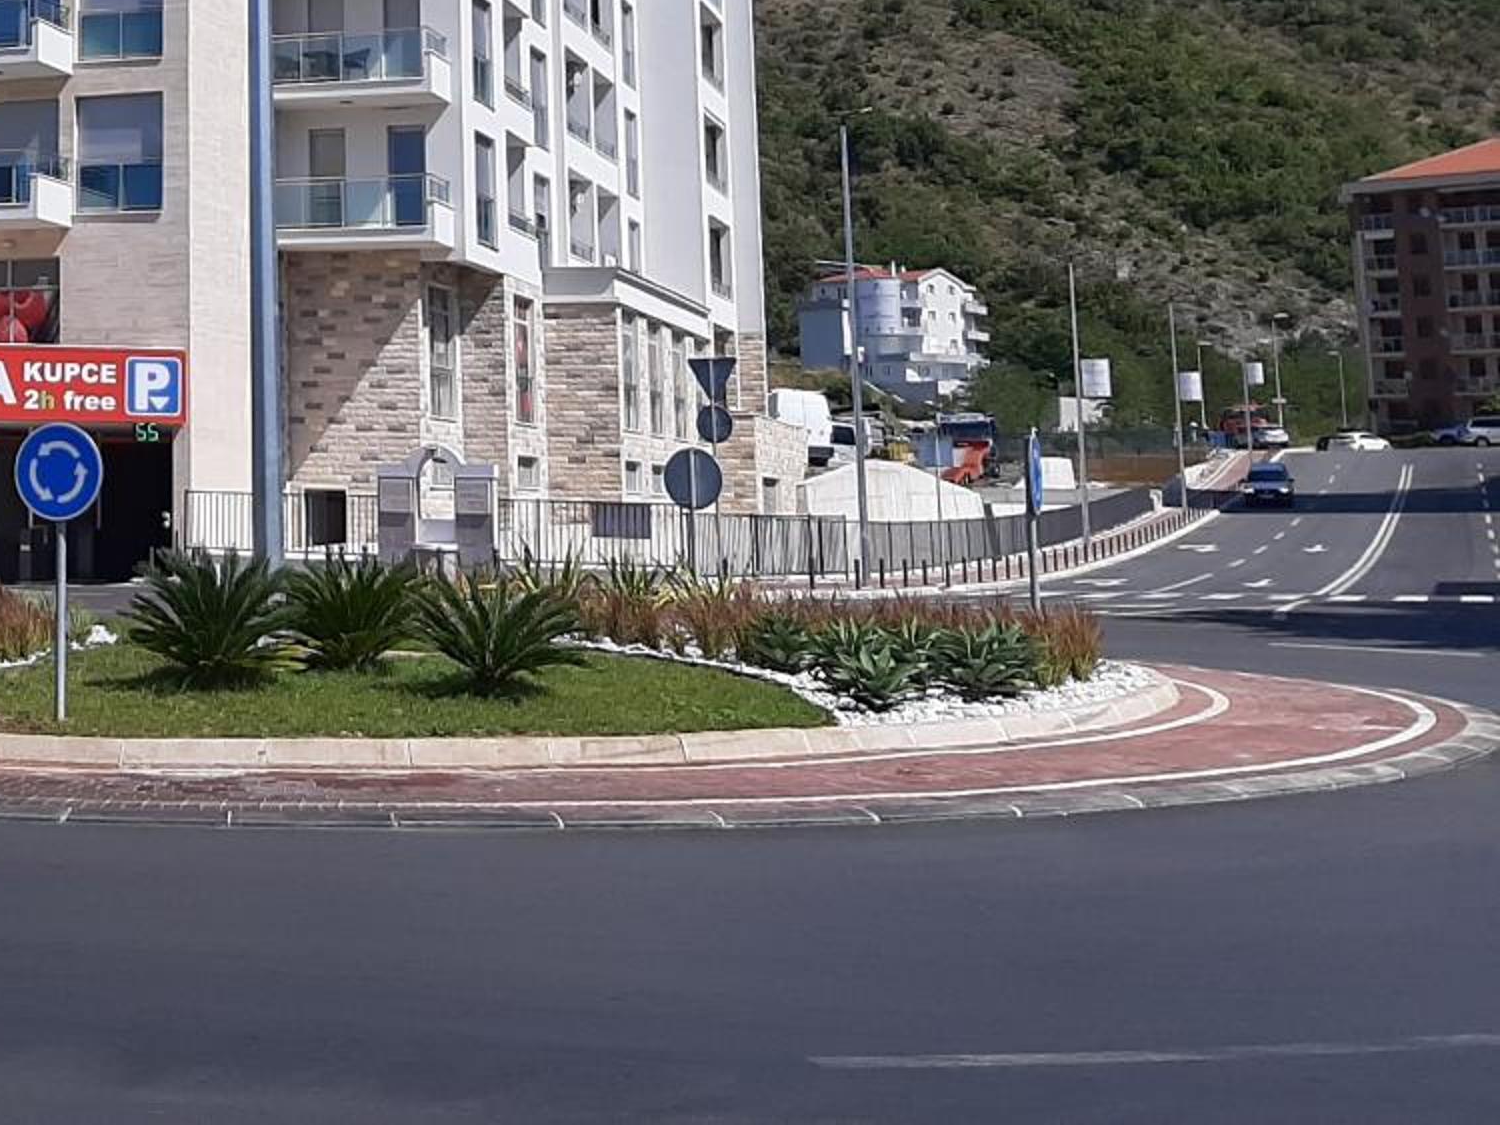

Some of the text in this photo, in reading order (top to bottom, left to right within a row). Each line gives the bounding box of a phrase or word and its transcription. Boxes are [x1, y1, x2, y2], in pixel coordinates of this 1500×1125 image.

[23, 361, 117, 384] KUPCE
[134, 362, 171, 412] P
[23, 390, 117, 412] 2h free
